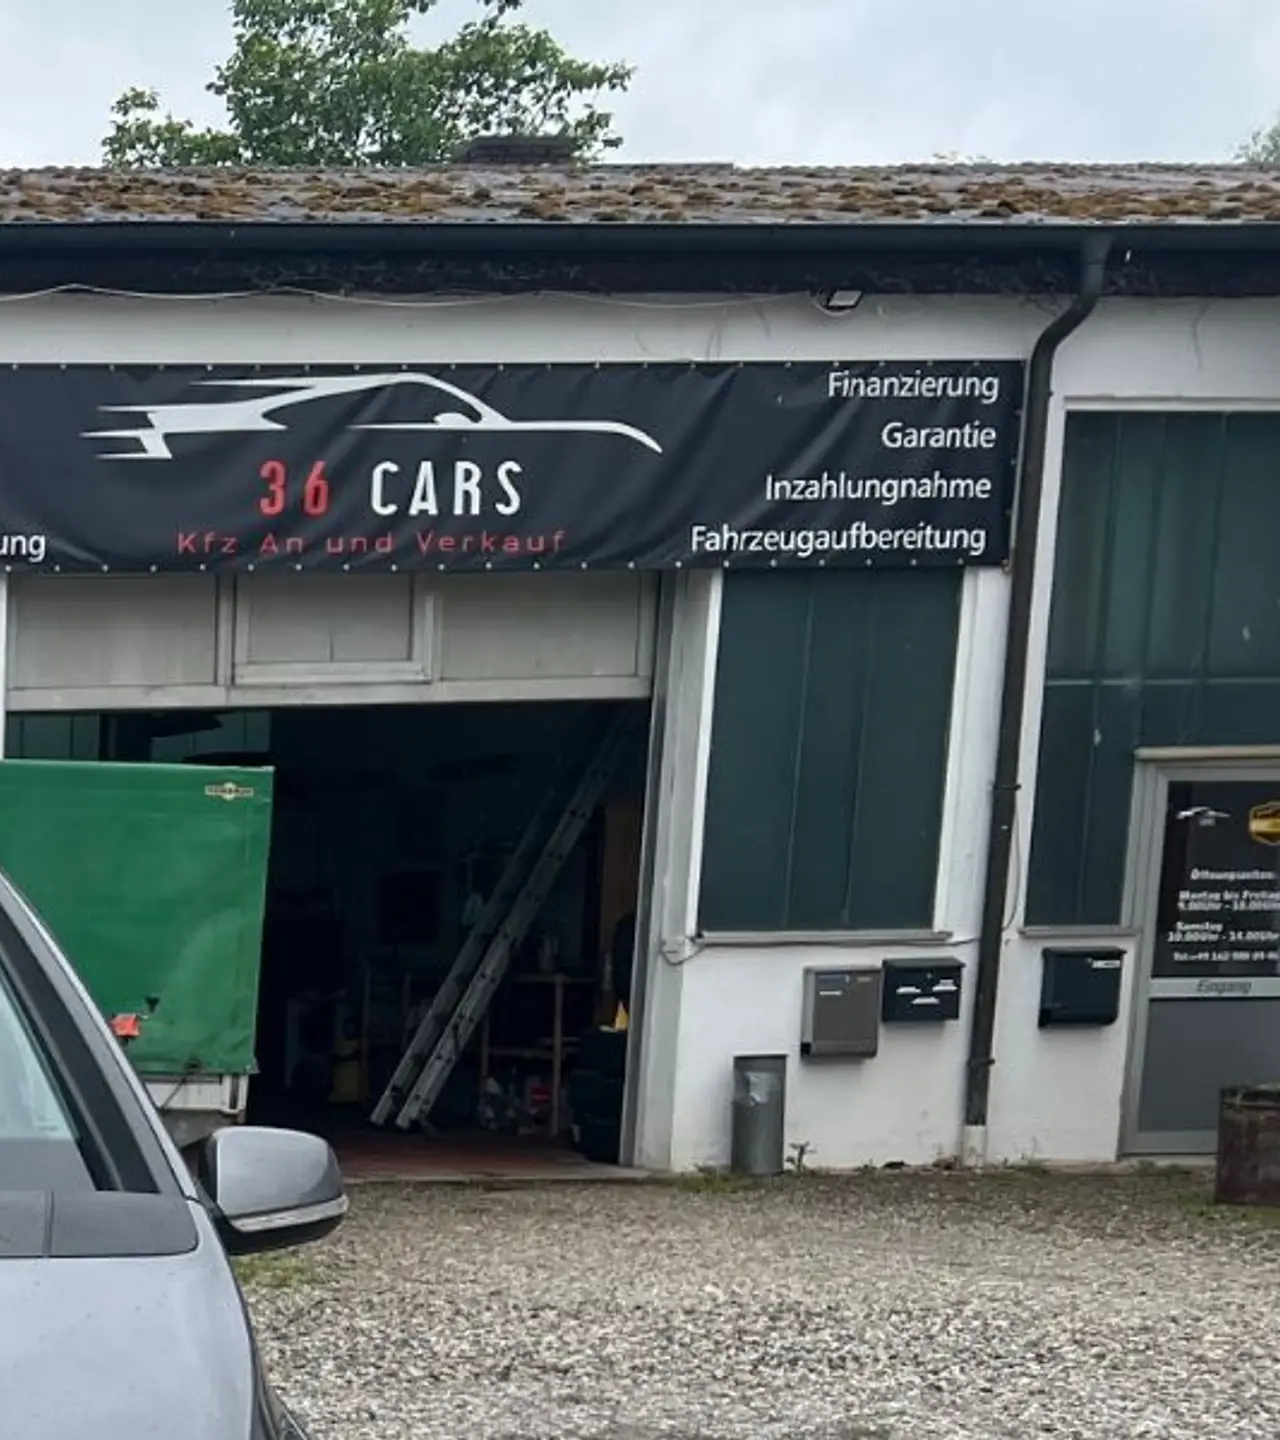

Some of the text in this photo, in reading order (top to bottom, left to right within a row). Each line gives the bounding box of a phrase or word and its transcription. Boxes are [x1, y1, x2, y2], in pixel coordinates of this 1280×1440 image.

[828, 372, 999, 403] Finanzierung
[881, 422, 995, 449] Garantie
[259, 460, 523, 516] 36 CARS
[765, 474, 992, 506] Inzahlungnahme
[177, 530, 565, 555] Kfz An und Verkauf
[691, 522, 986, 557] Fahrzeugaufbereitung
